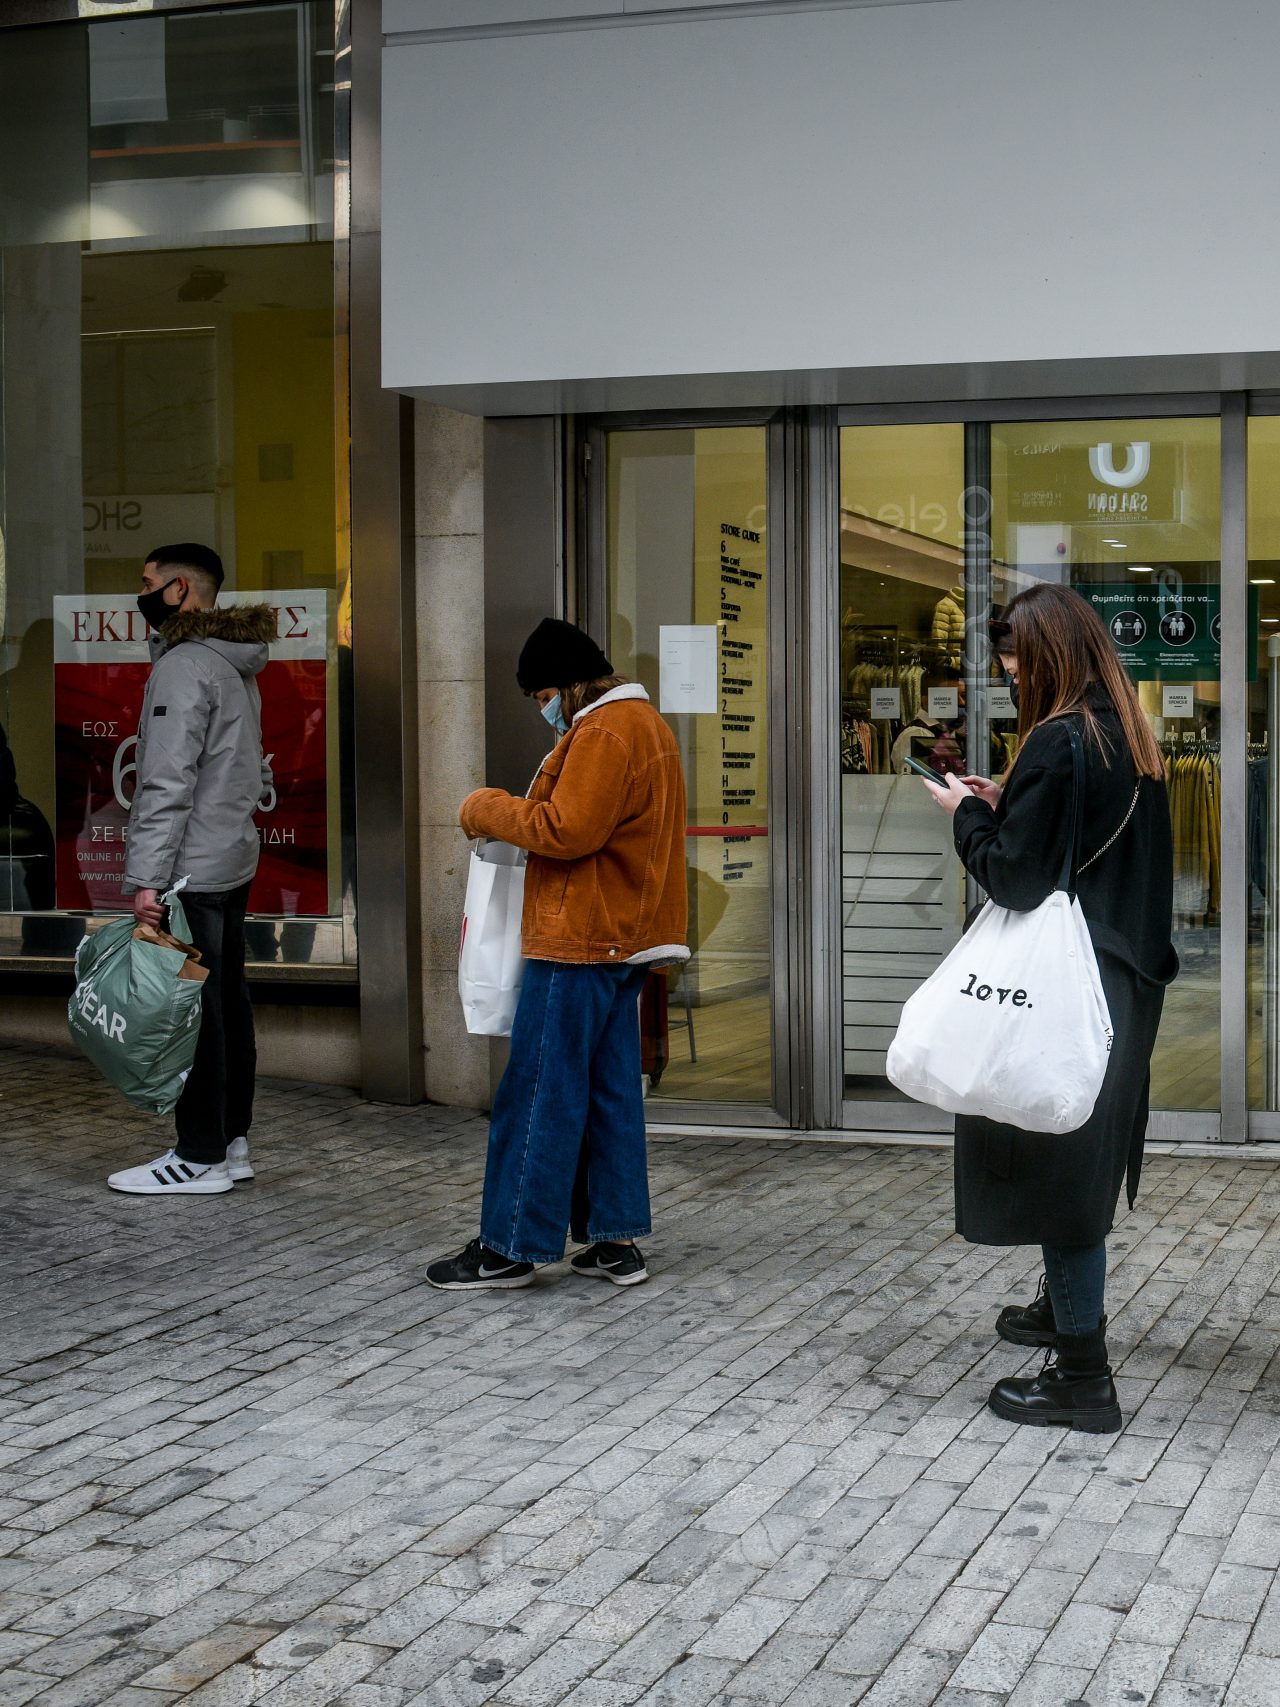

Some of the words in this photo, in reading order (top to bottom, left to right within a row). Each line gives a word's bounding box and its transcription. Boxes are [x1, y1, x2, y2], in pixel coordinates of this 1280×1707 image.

[721, 523, 741, 538] STORE
[742, 529, 760, 543] GUIDE
[721, 540, 726, 553] 6
[721, 587, 726, 600] 5
[1091, 594, 1135, 603] Θυμηθείτε
[1137, 594, 1149, 602] ότι
[722, 625, 727, 637] 4
[722, 662, 727, 675] 3
[722, 699, 727, 712] 2
[82, 721, 118, 737] ΕΩΣ
[722, 737, 726, 749] 1
[723, 811, 728, 825] 0
[92, 827, 114, 842] ΣΕ
[77, 852, 111, 862] ONLINE
[960, 973, 1033, 1009] love.
